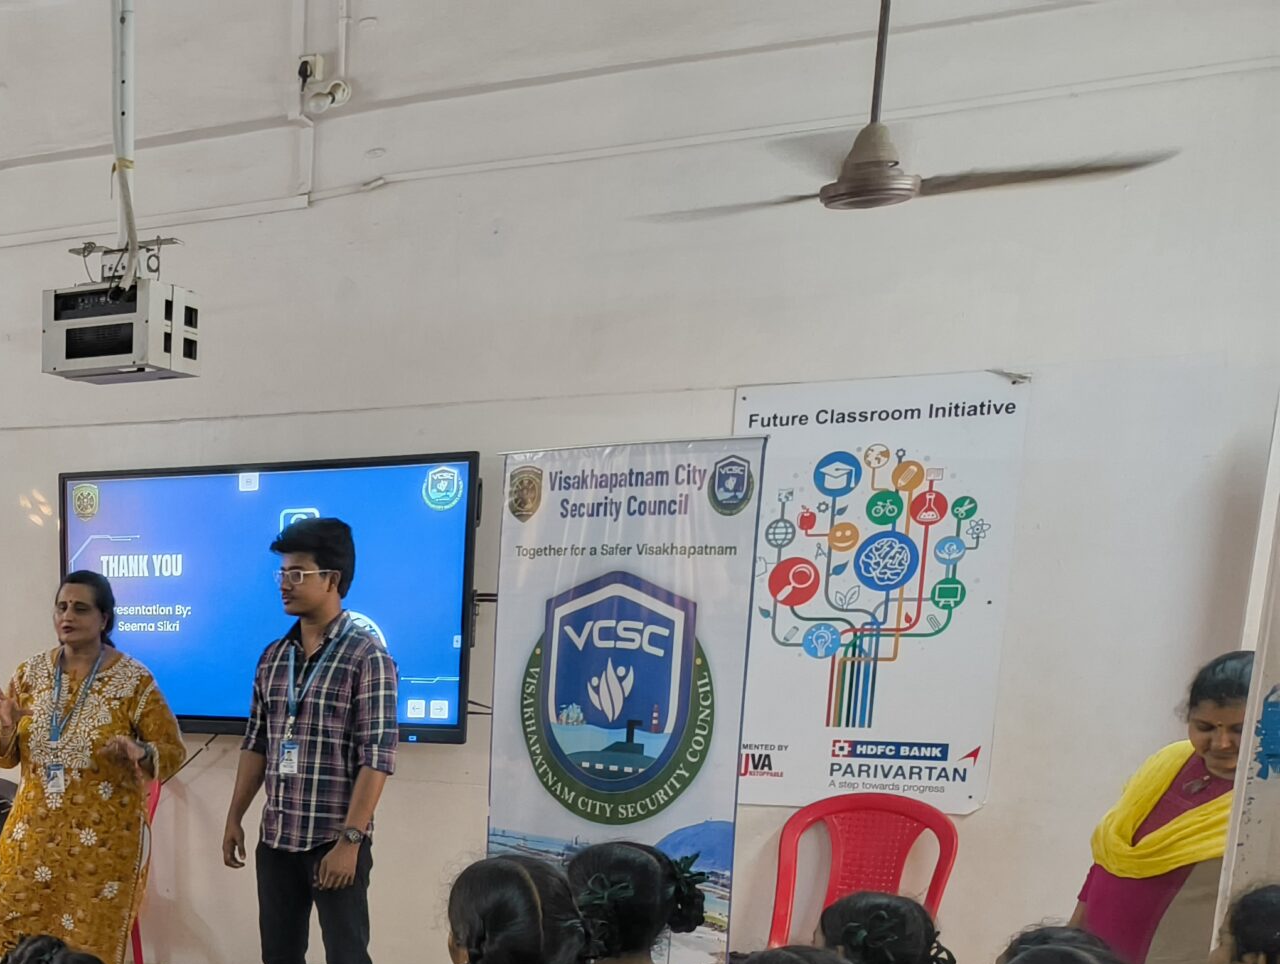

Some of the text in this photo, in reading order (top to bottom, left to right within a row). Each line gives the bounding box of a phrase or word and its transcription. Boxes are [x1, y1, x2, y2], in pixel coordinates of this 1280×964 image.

[749, 400, 1016, 428] Future Classroom Initiative
[549, 467, 670, 493] Visakhapatnam
[675, 464, 707, 488] City
[560, 496, 622, 522] Security
[627, 494, 689, 517] Council
[516, 543, 737, 560] Together for a Safer Visakhapatnam
[101, 554, 183, 578] THANK YOU
[113, 604, 192, 618] resentation By:
[118, 620, 180, 632] Seema Sikri
[564, 619, 669, 657] VCSC
[523, 667, 712, 819] VISAKHAPATNAM CITY SECURITY COUNCIL
[742, 743, 776, 751] MENTED
[856, 744, 942, 757] HDFC BANK
[739, 753, 772, 777] UVA
[829, 762, 967, 782] PARIVARTAN
[828, 780, 945, 793] A step towards progress
